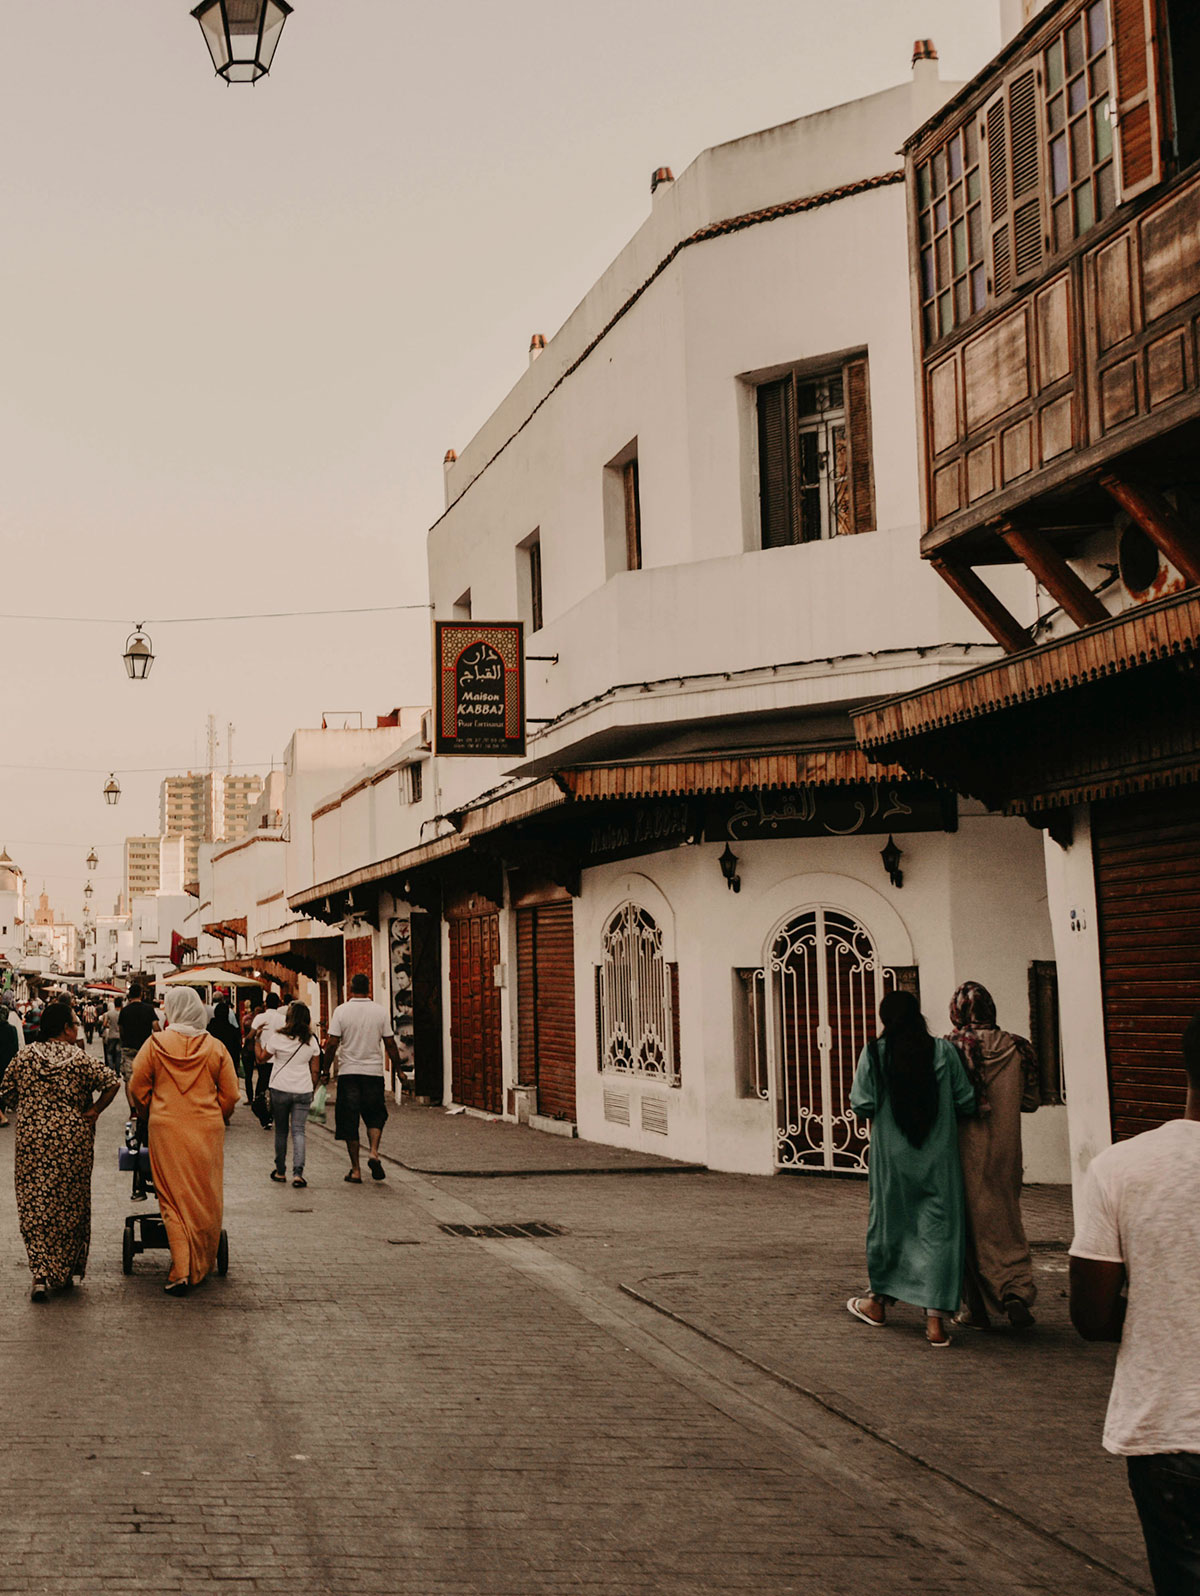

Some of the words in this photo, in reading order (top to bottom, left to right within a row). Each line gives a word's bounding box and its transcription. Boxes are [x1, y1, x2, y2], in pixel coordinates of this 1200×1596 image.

[462, 645, 498, 665] دار
[459, 665, 501, 687] القباج
[461, 691, 500, 701] Maison
[456, 703, 505, 715] KABBAJ
[727, 785, 816, 841] القباج
[823, 784, 912, 835] دار
